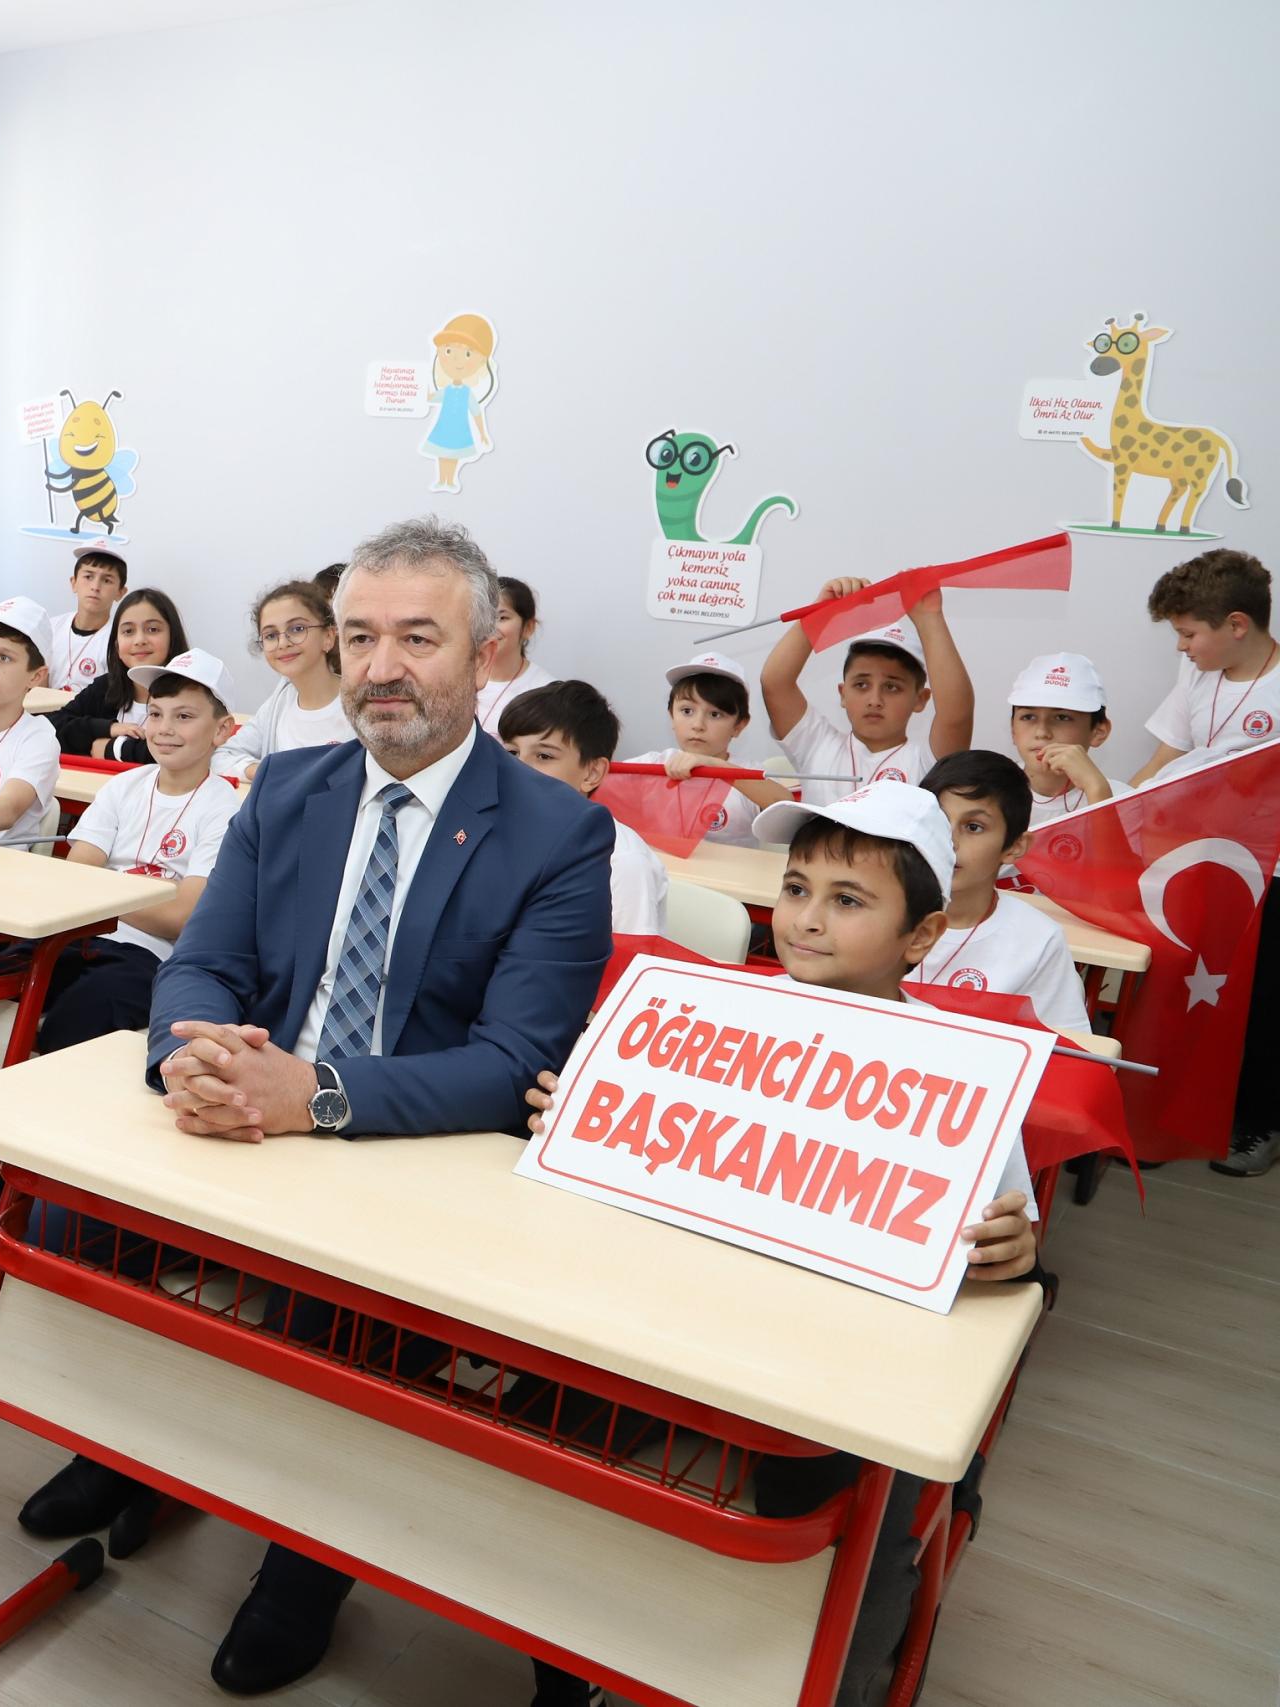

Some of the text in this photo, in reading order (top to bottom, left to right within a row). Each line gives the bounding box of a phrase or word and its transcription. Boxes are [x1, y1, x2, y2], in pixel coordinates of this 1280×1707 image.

[1029, 396, 1052, 407] İlkesi
[1053, 397, 1069, 409] Hız
[1033, 406, 1058, 419] Ömrü
[1059, 409, 1072, 421] Az
[667, 544, 747, 562] Çıkmayın yola
[681, 561, 729, 578] kemersiz
[665, 576, 741, 593] yoksa canınız
[657, 589, 675, 602] çok
[677, 593, 696, 602] mu
[616, 996, 989, 1148] ÖĞRENCİ DOSTU
[571, 1079, 952, 1247] BAŞKANIMIZ
